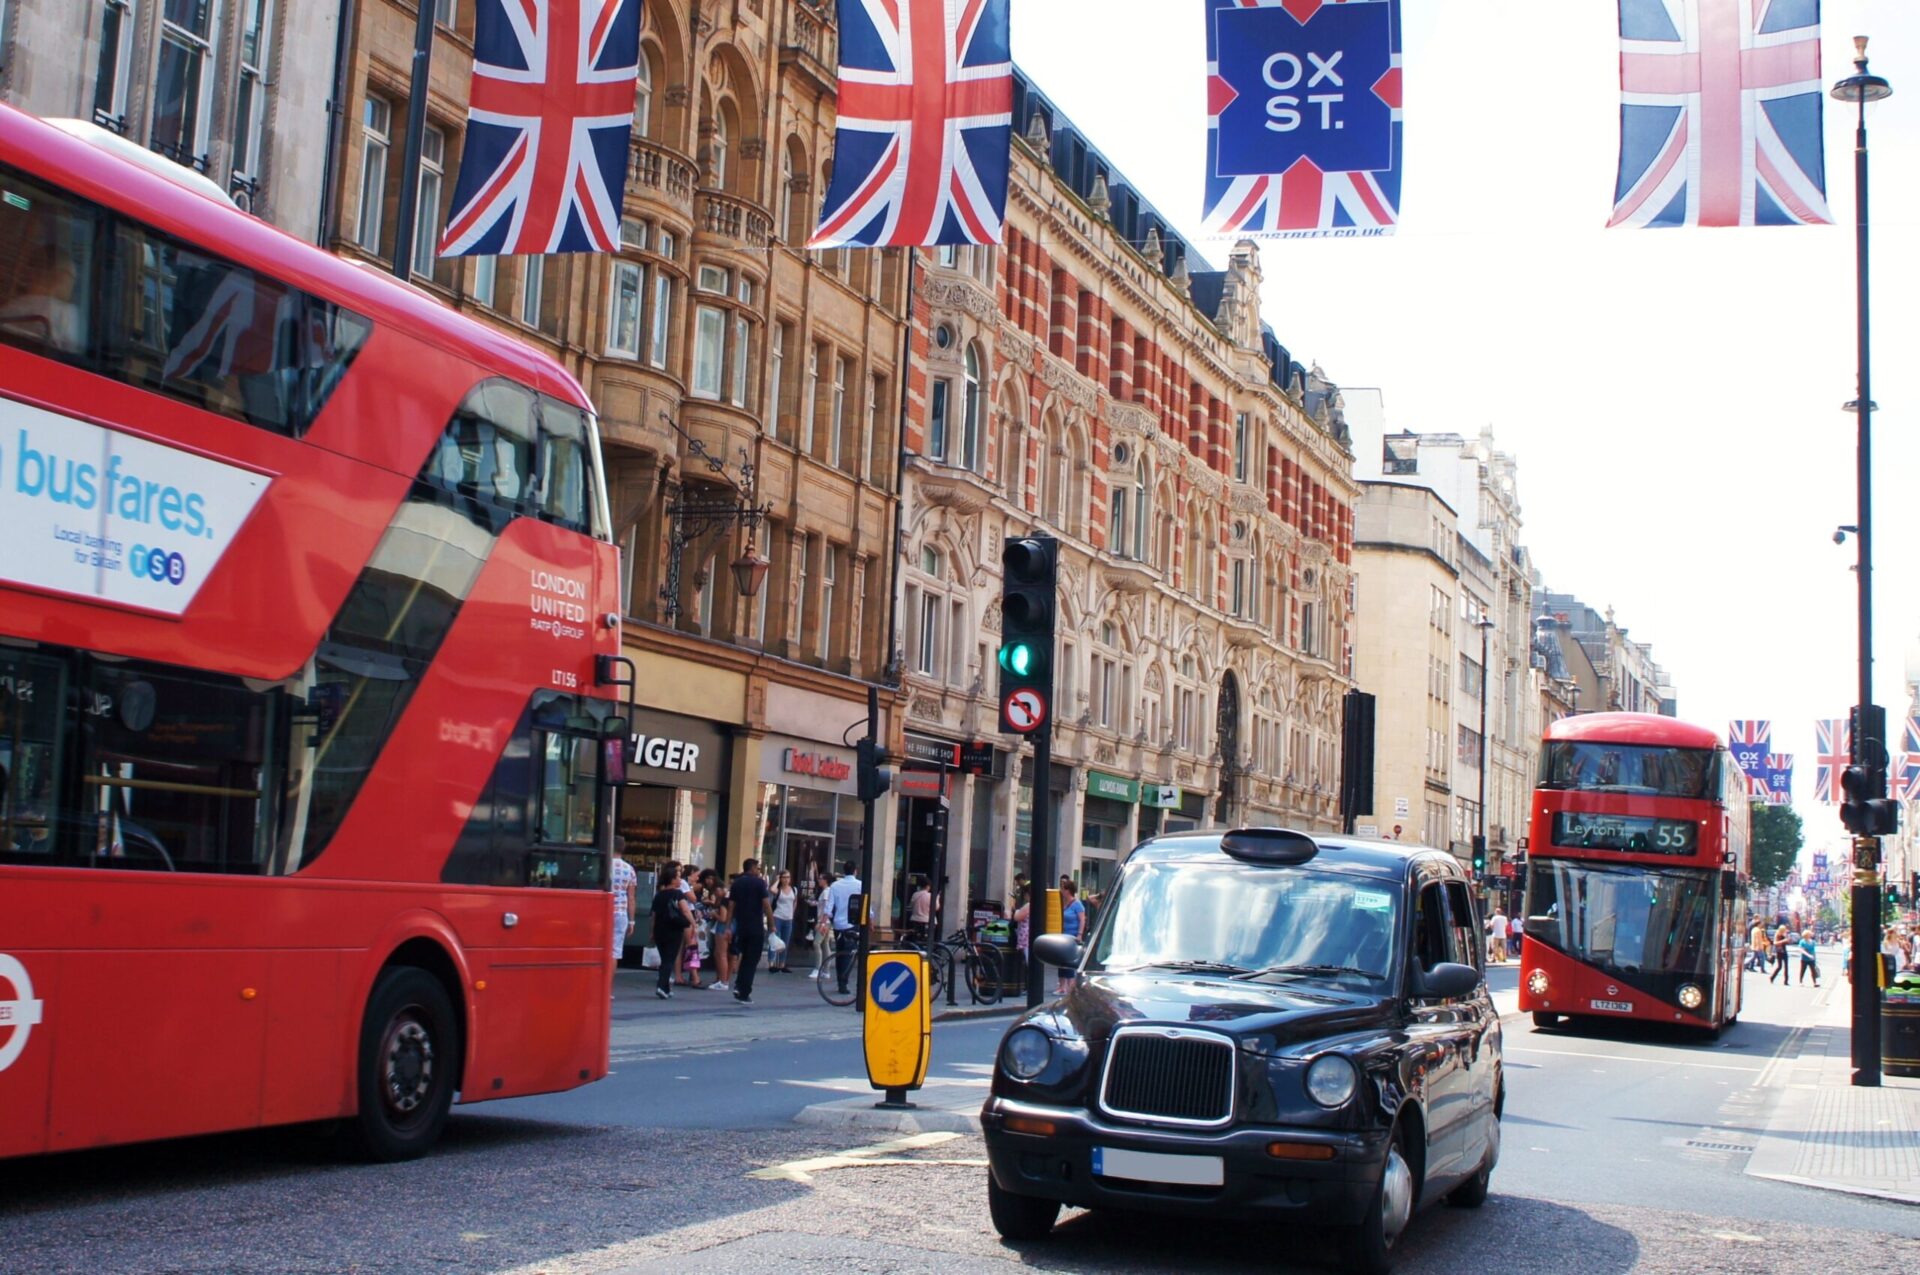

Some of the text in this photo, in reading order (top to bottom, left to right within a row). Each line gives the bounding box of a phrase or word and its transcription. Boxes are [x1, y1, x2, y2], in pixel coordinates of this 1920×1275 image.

[1262, 51, 1344, 91] OX
[1264, 93, 1344, 132] ST.
[17, 429, 97, 509] bus
[104, 454, 213, 539] fares.
[131, 547, 184, 582] TSB
[531, 569, 585, 600] LONDON
[531, 594, 585, 623] UNITED
[561, 625, 585, 639] GROUP
[631, 733, 700, 772] IGER
[1739, 751, 1760, 761] OX
[1565, 820, 1616, 839] Leyton
[1656, 825, 1686, 848] 55
